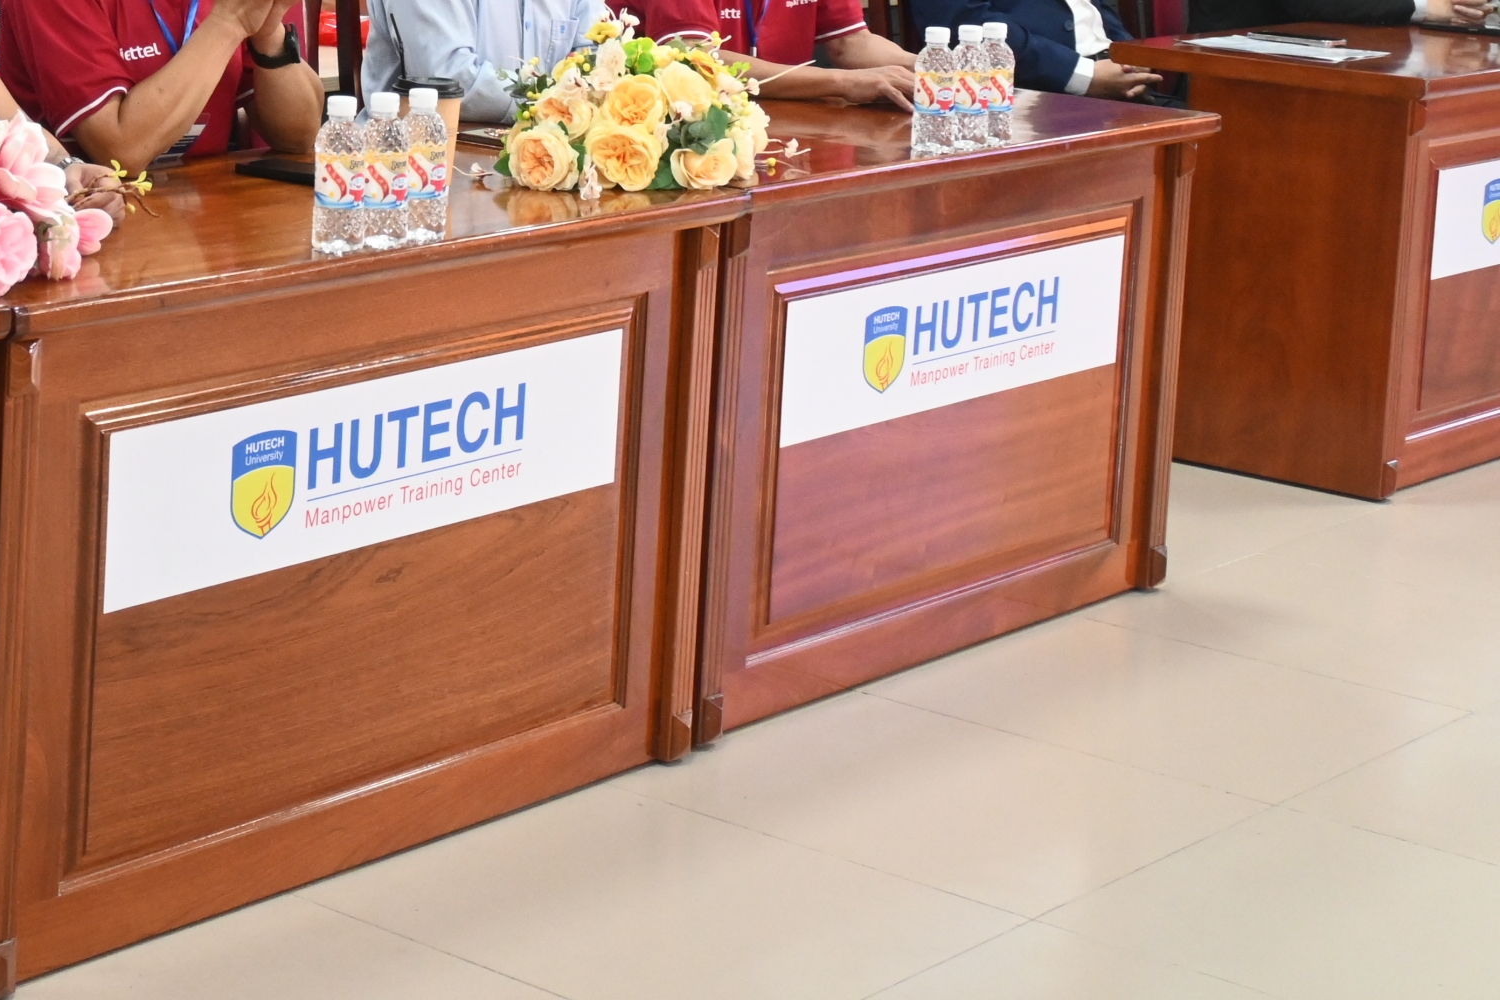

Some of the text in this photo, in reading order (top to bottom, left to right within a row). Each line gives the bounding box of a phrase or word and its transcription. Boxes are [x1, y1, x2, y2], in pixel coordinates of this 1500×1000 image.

[119, 43, 161, 61] iettel
[873, 311, 900, 325] HUTECH
[913, 276, 1060, 356] HUTECH
[873, 322, 898, 334] University
[910, 341, 1055, 387] Manpower Training Center
[245, 436, 285, 455] HUTECH
[307, 382, 527, 491] HUTECH
[245, 450, 283, 466] University
[305, 462, 522, 529] Manpower Training Center
